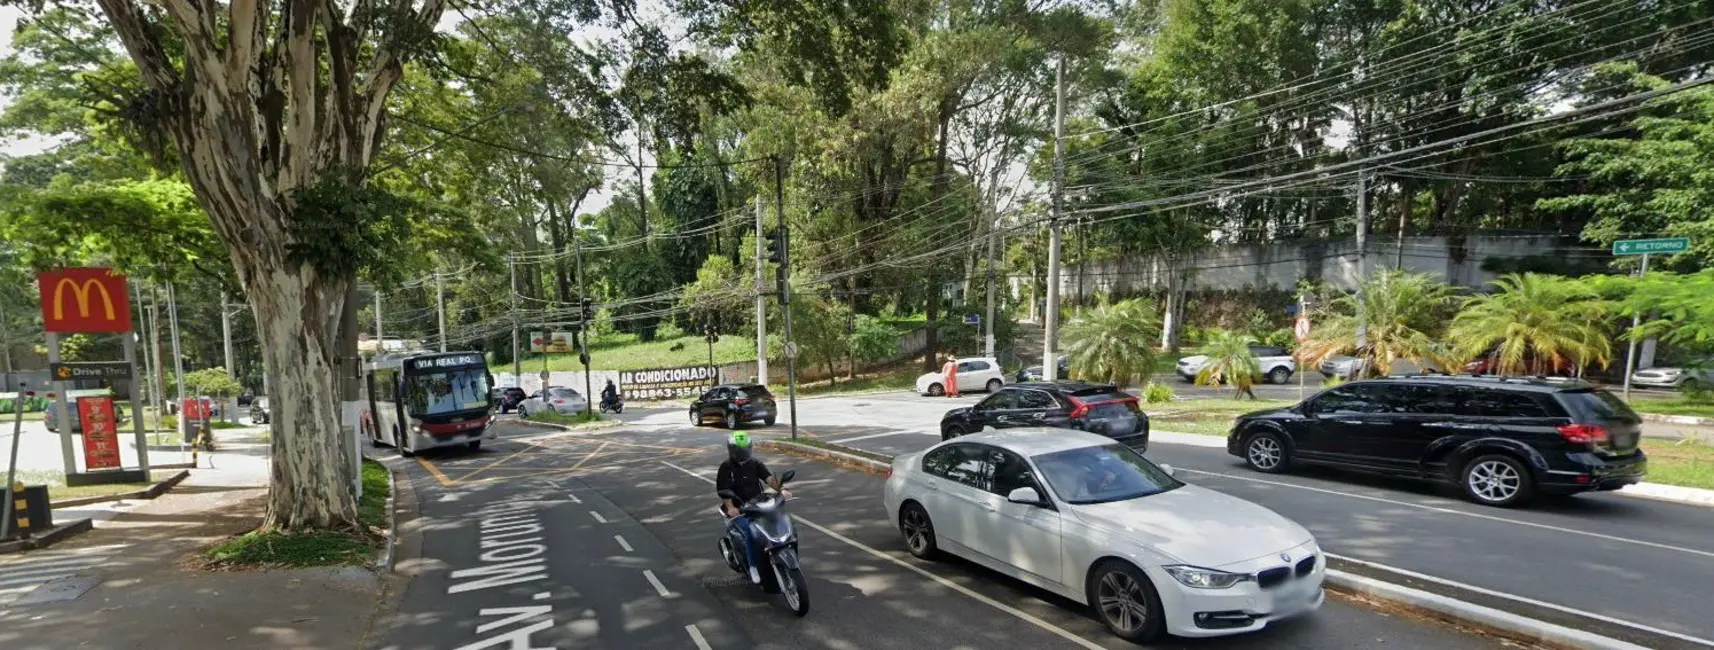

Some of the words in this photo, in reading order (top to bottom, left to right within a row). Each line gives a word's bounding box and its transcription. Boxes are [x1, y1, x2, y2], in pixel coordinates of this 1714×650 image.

[1635, 241, 1683, 250] RETORNO
[418, 360, 433, 368] VIA
[436, 357, 456, 367] REAL
[72, 367, 102, 376] Drive
[104, 367, 127, 375] Thru
[621, 371, 633, 384] AR
[635, 366, 716, 384] CONDICIONADO
[453, 591, 558, 650] Av.
